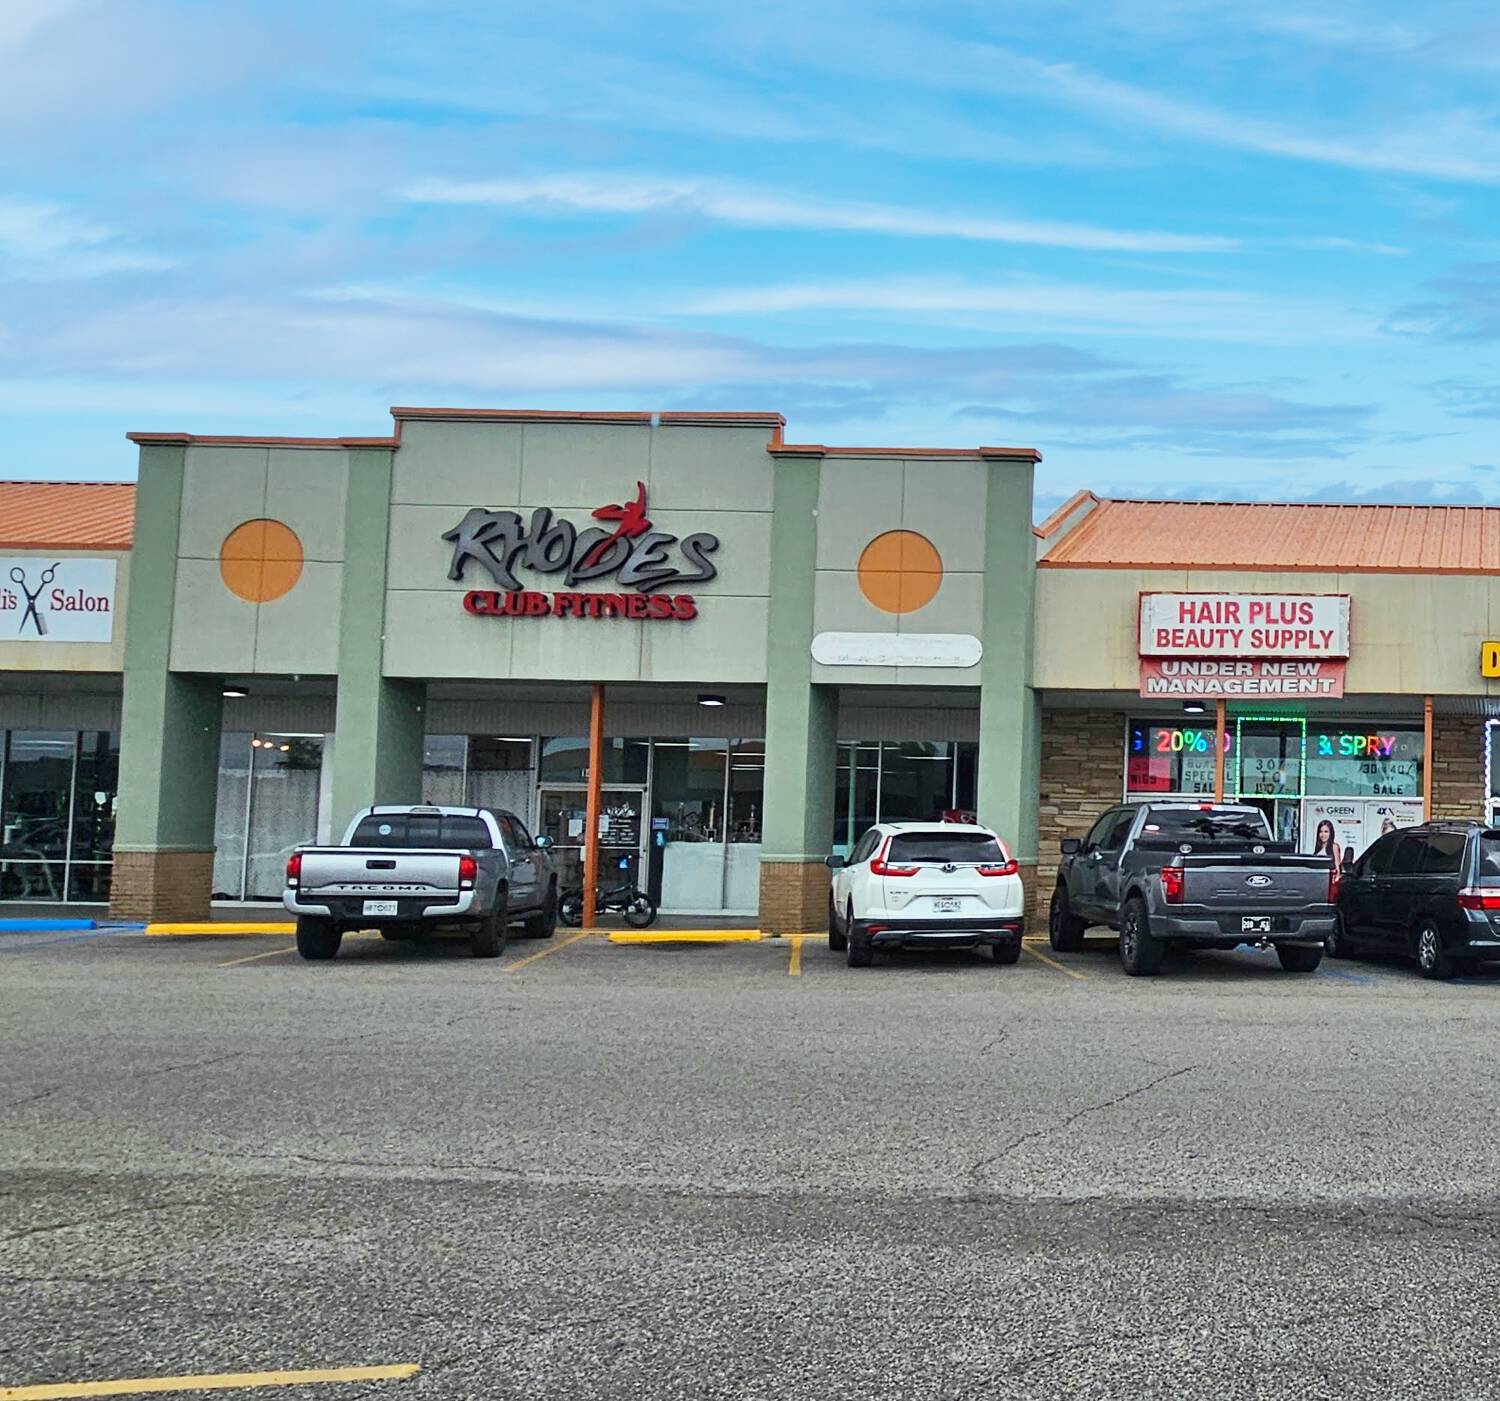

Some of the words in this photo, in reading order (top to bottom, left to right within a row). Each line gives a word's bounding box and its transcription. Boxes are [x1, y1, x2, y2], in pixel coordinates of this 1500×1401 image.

[0, 588, 17, 610] i's
[50, 588, 110, 612] Salon
[463, 591, 550, 617] CLUB
[552, 592, 698, 620] FITNESS
[1179, 601, 1240, 624] HAIR
[1249, 602, 1313, 625] PLUS
[1156, 628, 1243, 648] BEAUTY
[1251, 630, 1334, 649] SUPPLY
[1161, 661, 1254, 676] UNDER
[1261, 662, 1321, 676] NEW
[1147, 678, 1336, 694] MANAGEMENT
[1157, 731, 1207, 752] 20%
[1319, 735, 1333, 755] &
[1339, 735, 1396, 757] SPRY
[1185, 770, 1233, 781] SPECL
[1194, 782, 1215, 793] SAL
[1373, 784, 1403, 795] SALE
[1326, 806, 1355, 815] GREEN
